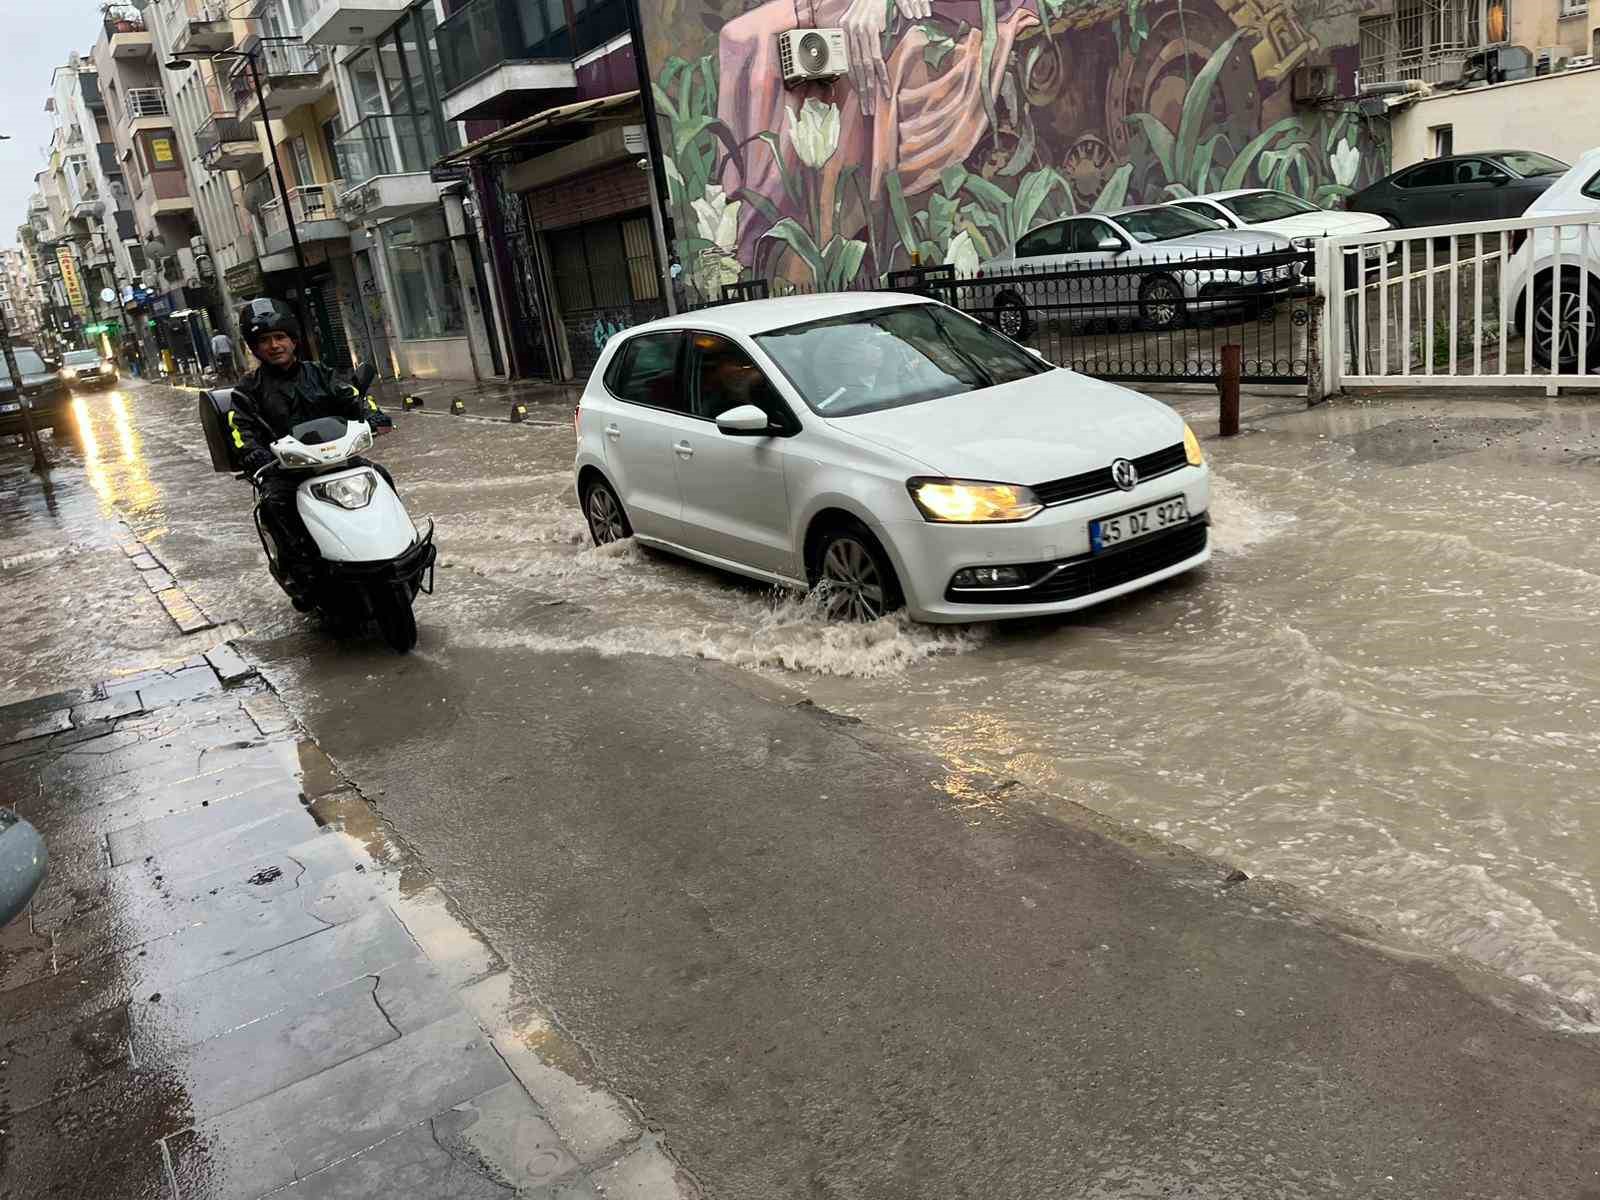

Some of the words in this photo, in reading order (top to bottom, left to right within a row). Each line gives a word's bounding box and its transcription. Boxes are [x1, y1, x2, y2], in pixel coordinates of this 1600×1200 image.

[1103, 520, 1121, 543] 45
[1129, 511, 1150, 535] DZ
[1157, 501, 1186, 527] 922
